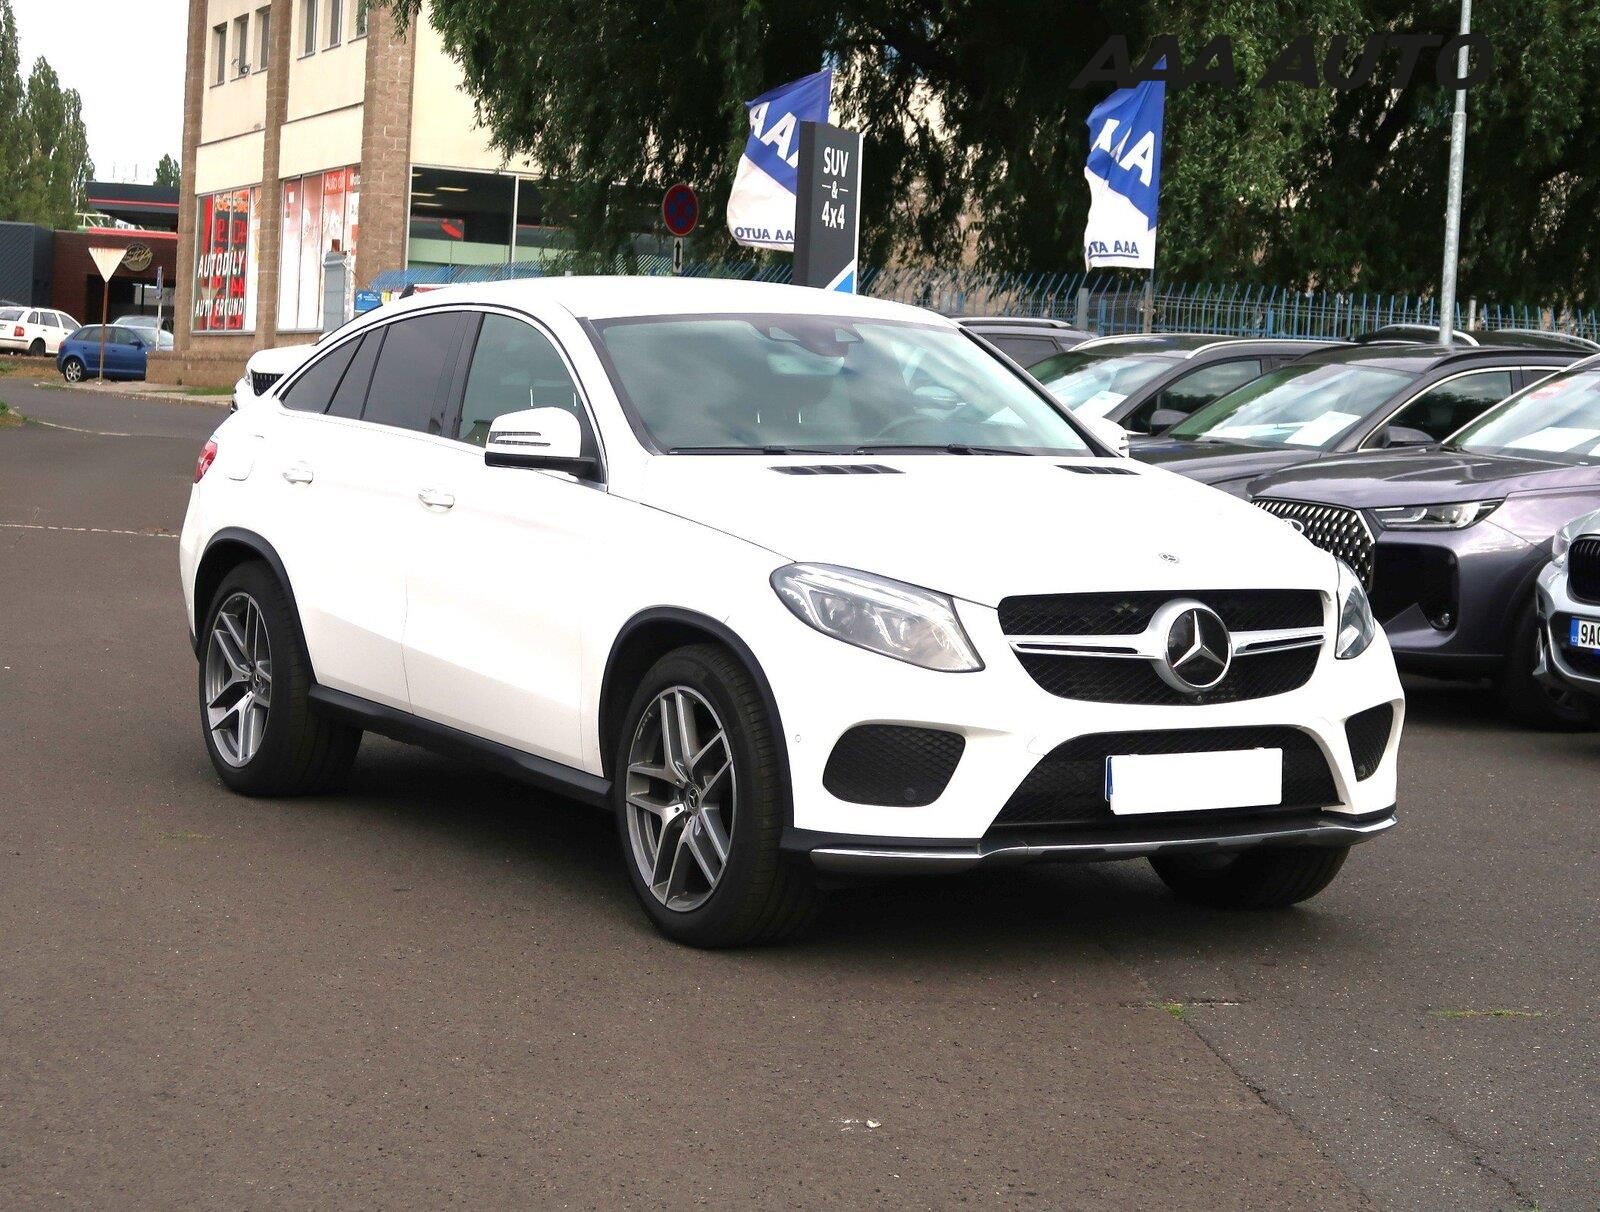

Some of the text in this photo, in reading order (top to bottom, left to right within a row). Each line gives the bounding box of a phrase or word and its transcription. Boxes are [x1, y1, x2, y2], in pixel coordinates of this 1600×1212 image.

[823, 146, 849, 178] SUV
[831, 180, 838, 199] &
[821, 200, 846, 230] 4x4
